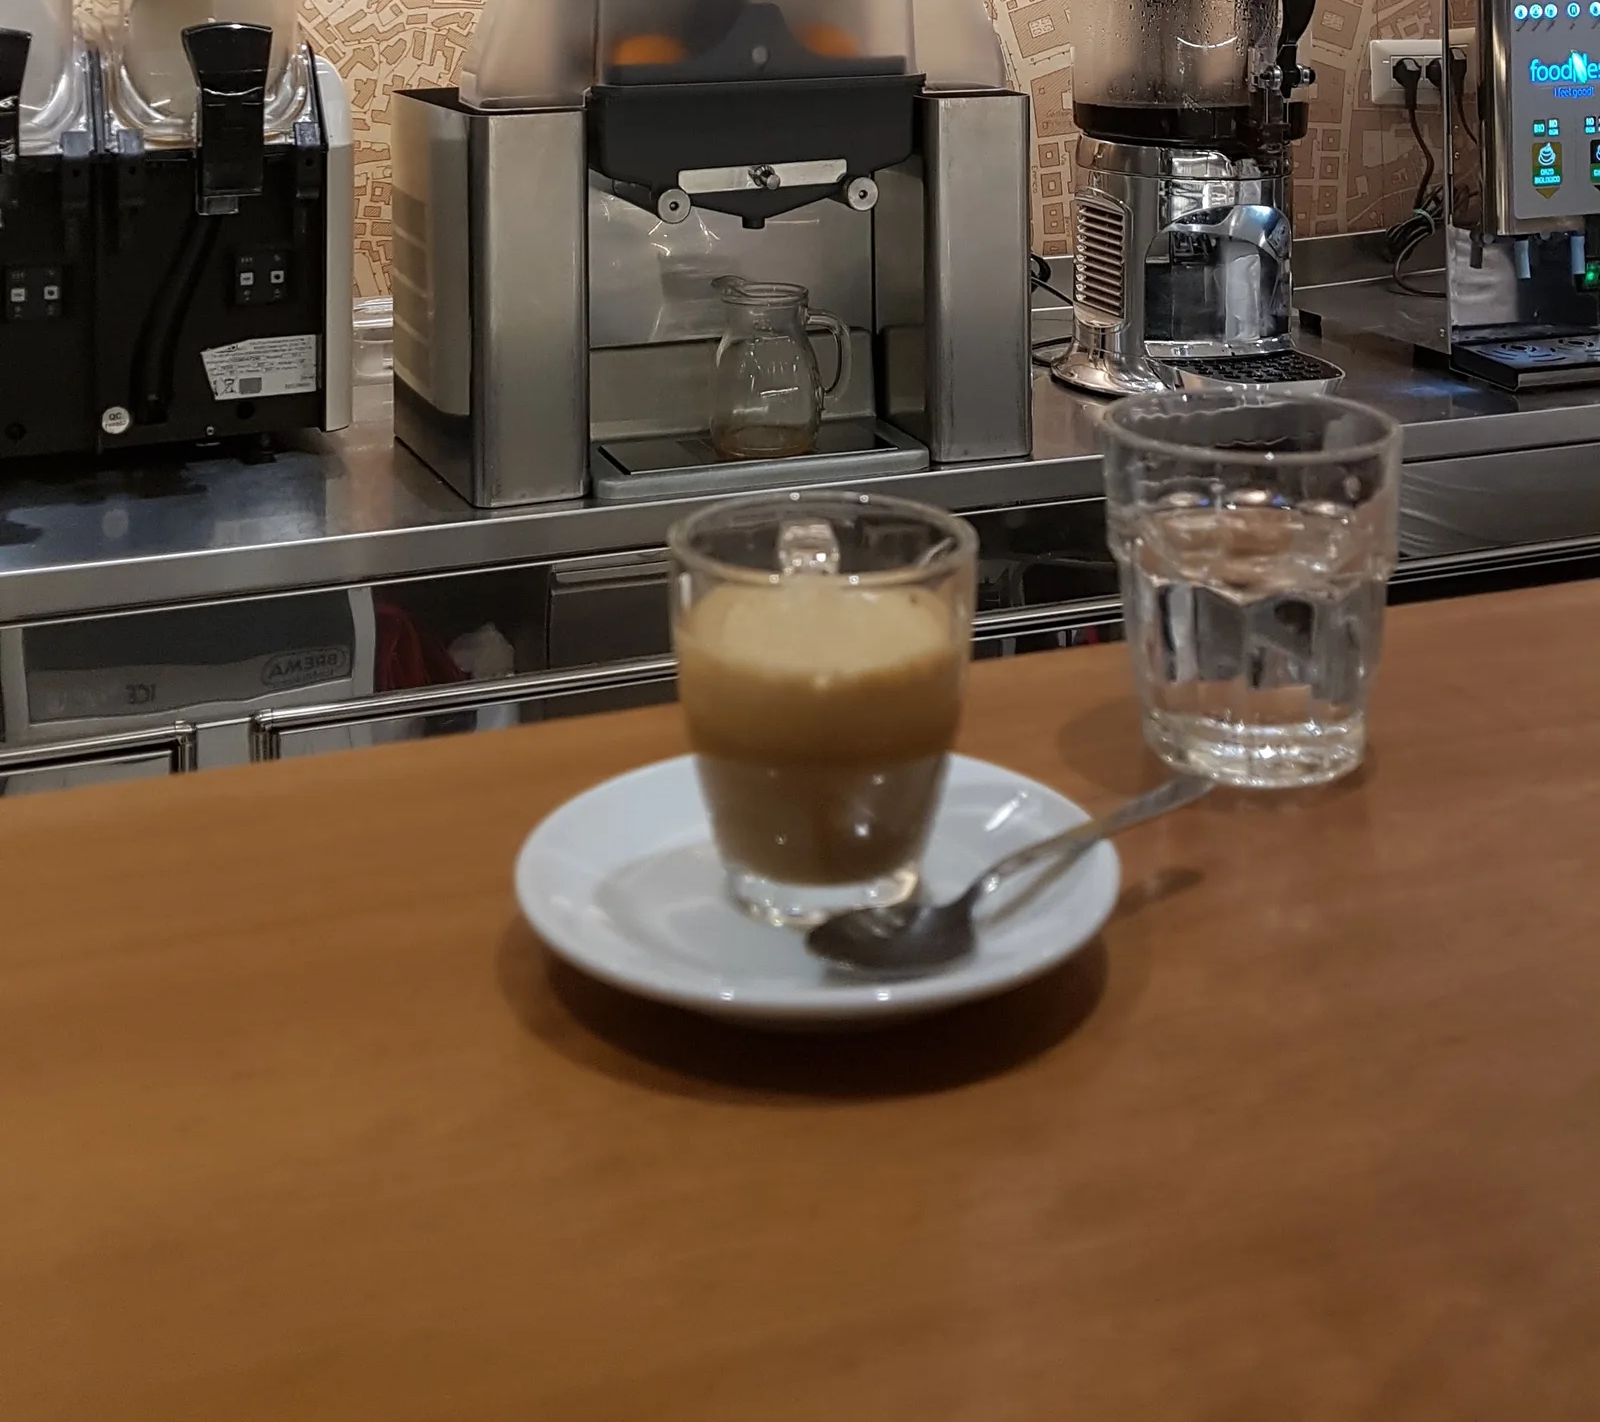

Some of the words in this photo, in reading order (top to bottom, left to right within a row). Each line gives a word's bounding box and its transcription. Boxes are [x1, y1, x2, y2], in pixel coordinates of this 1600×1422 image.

[1557, 87, 1572, 97] feel
[1572, 87, 1594, 99] good!
[108, 412, 122, 421] QC
